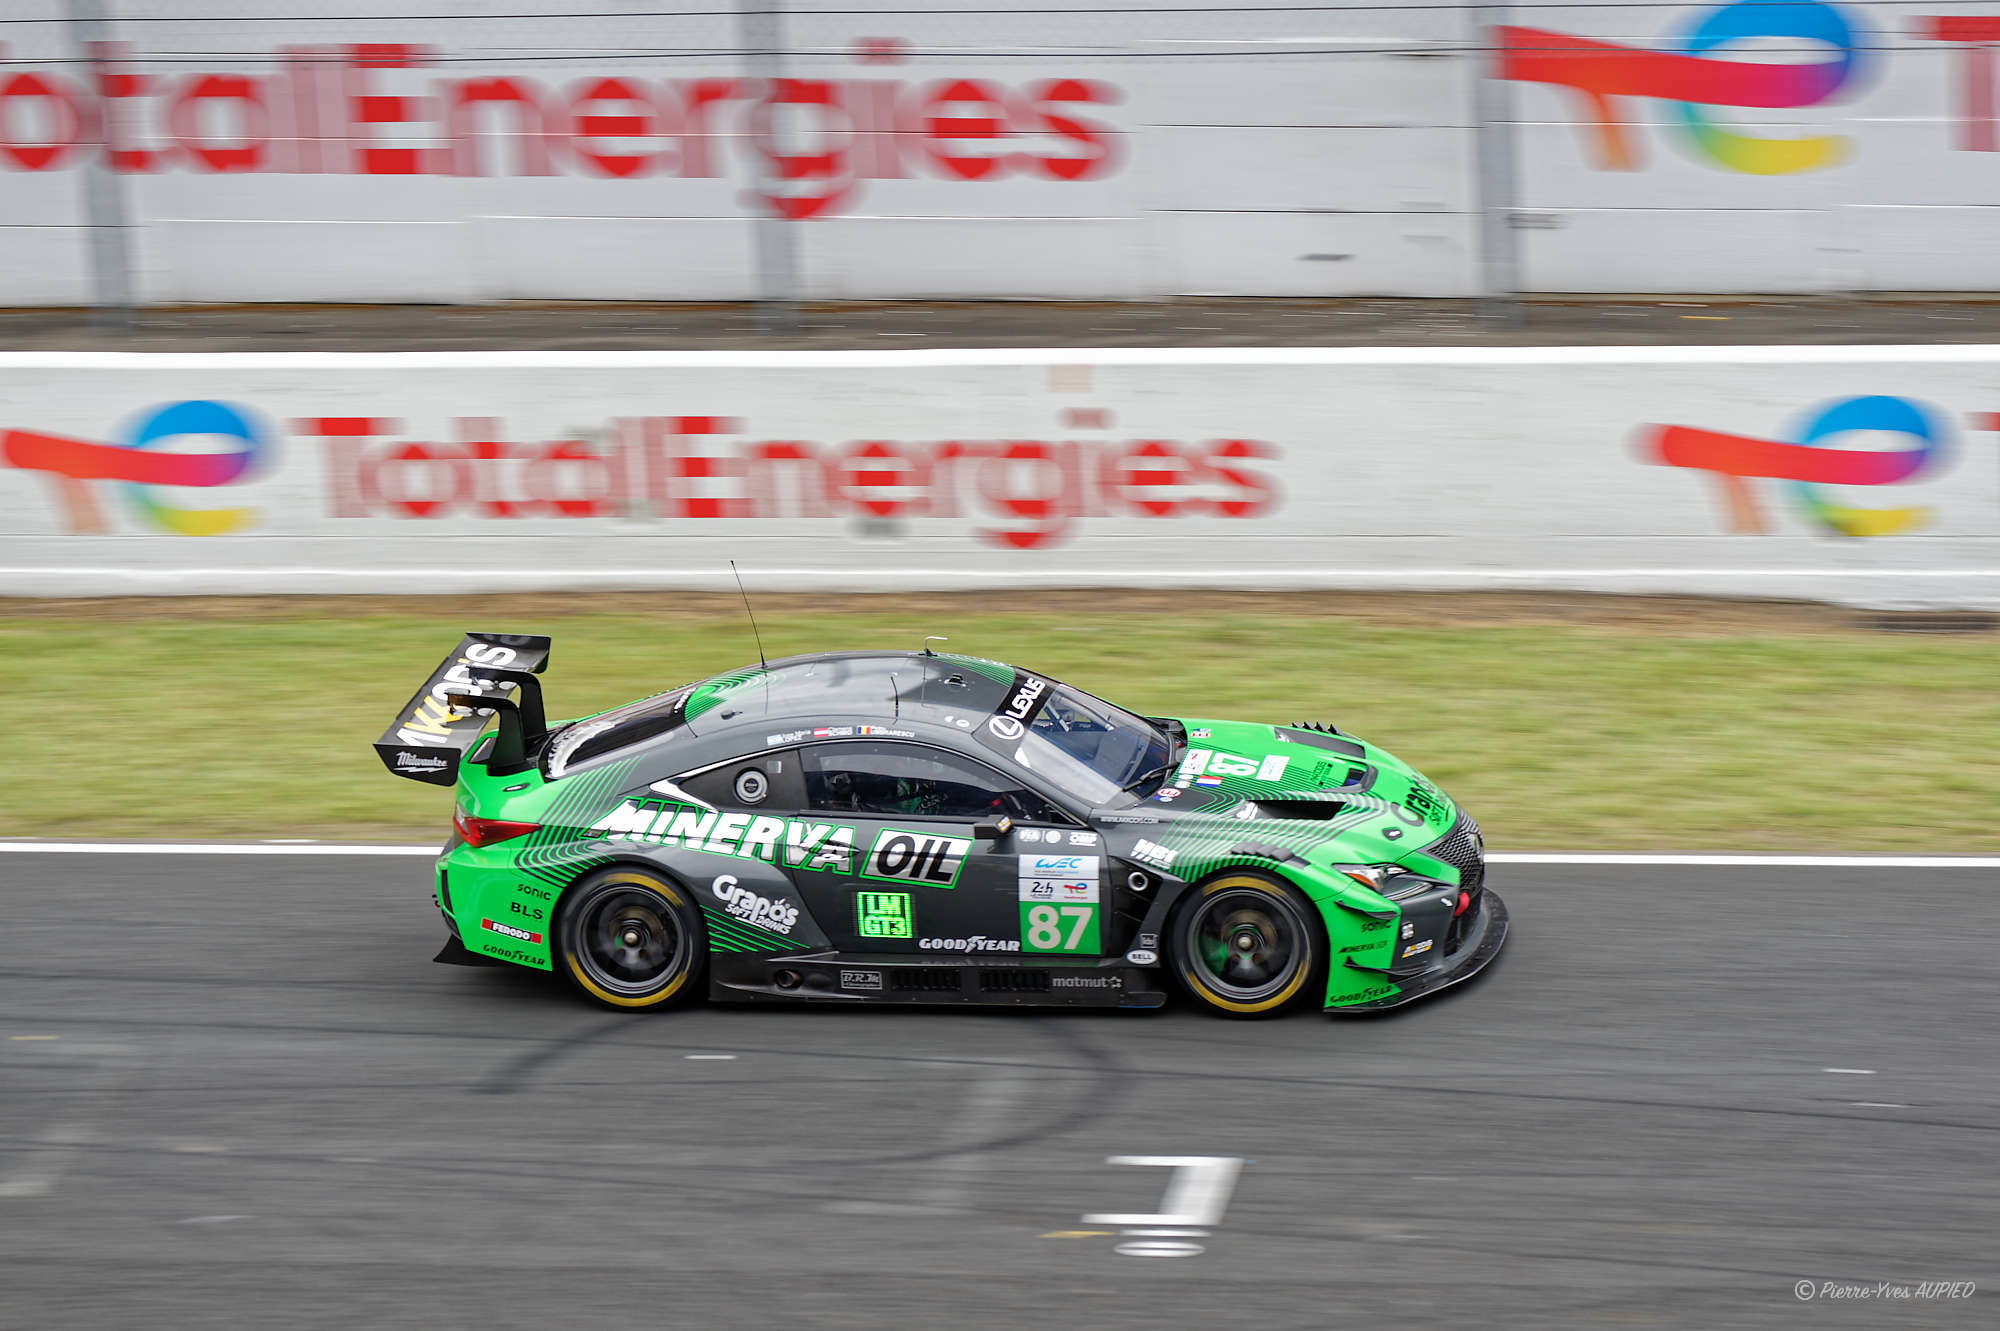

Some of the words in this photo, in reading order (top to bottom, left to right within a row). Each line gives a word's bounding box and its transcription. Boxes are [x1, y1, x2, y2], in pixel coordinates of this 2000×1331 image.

[0, 37, 1126, 220] otalEnergies
[293, 407, 1282, 549] TotalEnergies
[1005, 677, 1046, 719] LEXUS
[396, 752, 448, 767] Milwaukee
[584, 797, 856, 875] MINERVA
[875, 834, 956, 883] OIL
[1035, 858, 1082, 868] WEC
[511, 902, 543, 920] BLS
[866, 895, 901, 914] LM
[492, 922, 531, 941] FERODO
[864, 915, 906, 935] GT3
[1028, 905, 1093, 950] 87
[919, 936, 1020, 952] GOODYEAR
[483, 944, 545, 966] GOODYEAR
[1052, 975, 1107, 988] matmut
